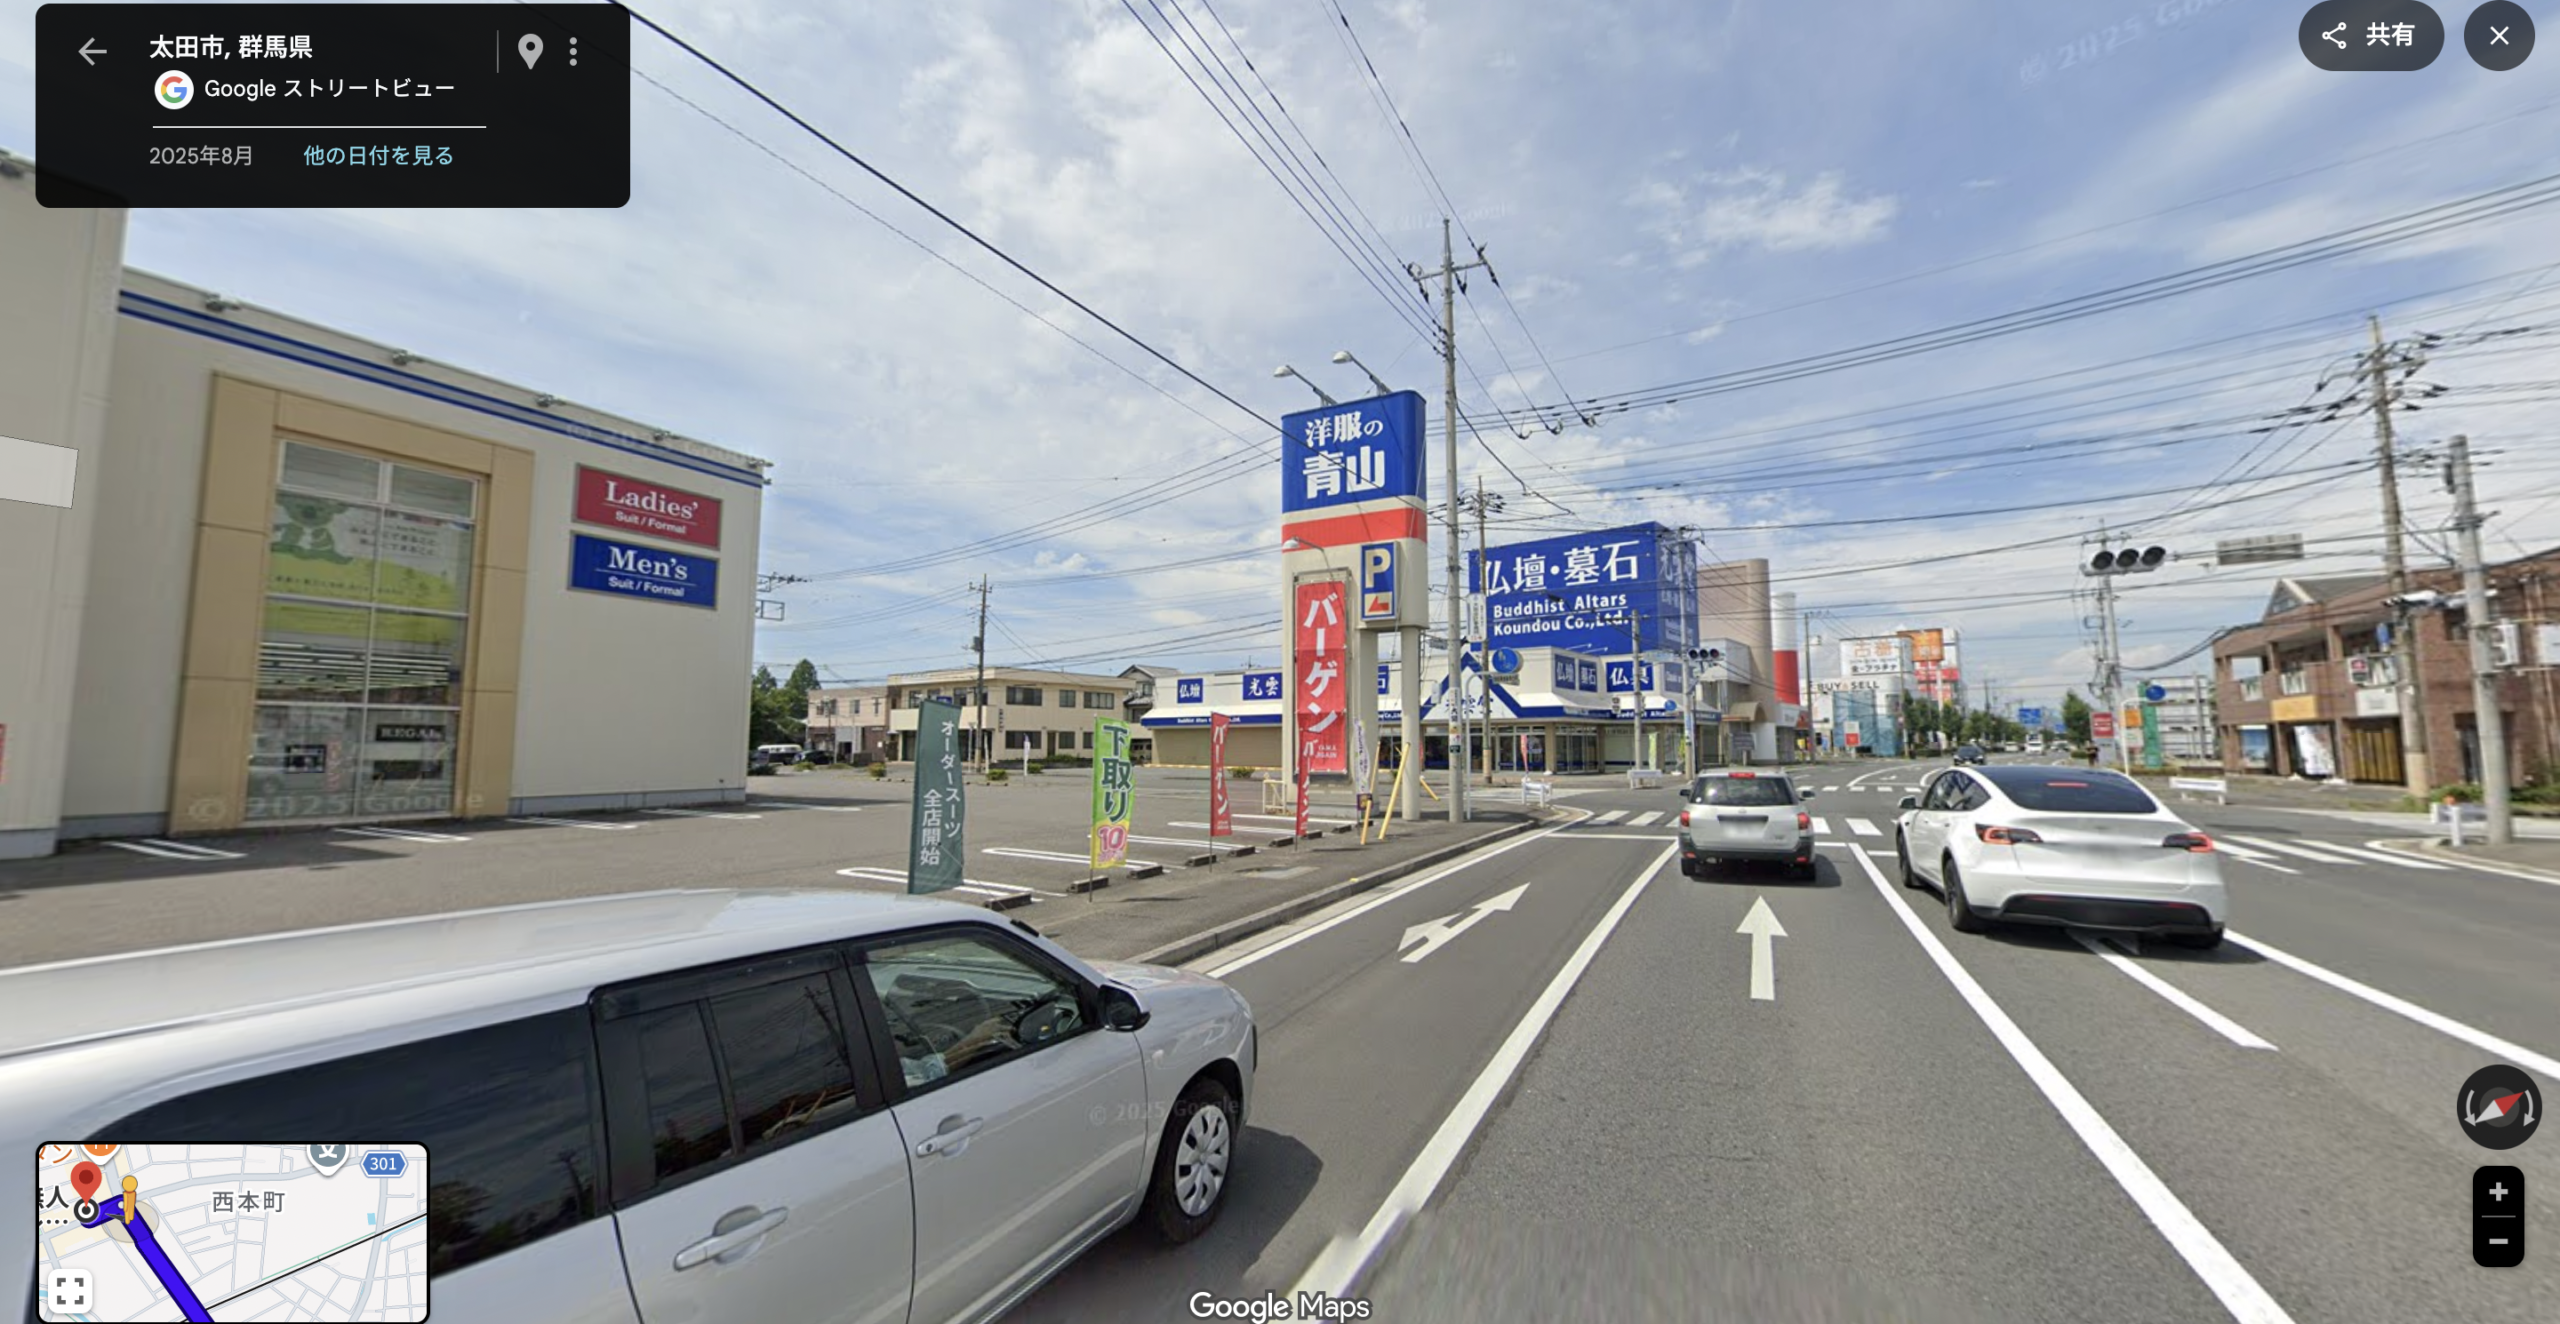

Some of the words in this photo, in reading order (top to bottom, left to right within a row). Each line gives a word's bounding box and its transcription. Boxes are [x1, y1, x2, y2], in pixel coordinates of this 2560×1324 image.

[1305, 411, 1384, 448] 洋服の
[1302, 446, 1385, 499] 青山
[615, 510, 640, 525] Suit
[649, 518, 687, 534] Formal
[608, 576, 634, 590] Suit
[643, 583, 685, 597] Formal
[1364, 548, 1391, 589] P
[1479, 540, 1640, 597] 仏壇・墓石
[1493, 597, 1565, 619] Buddhist
[1574, 593, 1627, 611] Altars
[1493, 618, 1561, 636] Koundou
[1564, 611, 1629, 630] Co.,Ltd.
[1303, 591, 1339, 733] バーゲン
[1180, 683, 1200, 698] 仏壇
[1248, 676, 1279, 696] 光雲
[1851, 680, 1880, 690] SELL
[941, 720, 961, 838] オーダースーツ
[1102, 724, 1133, 824] 下取り
[1213, 724, 1228, 815] バーゲン
[920, 788, 943, 866] 全店開始
[1097, 825, 1127, 851] 10
